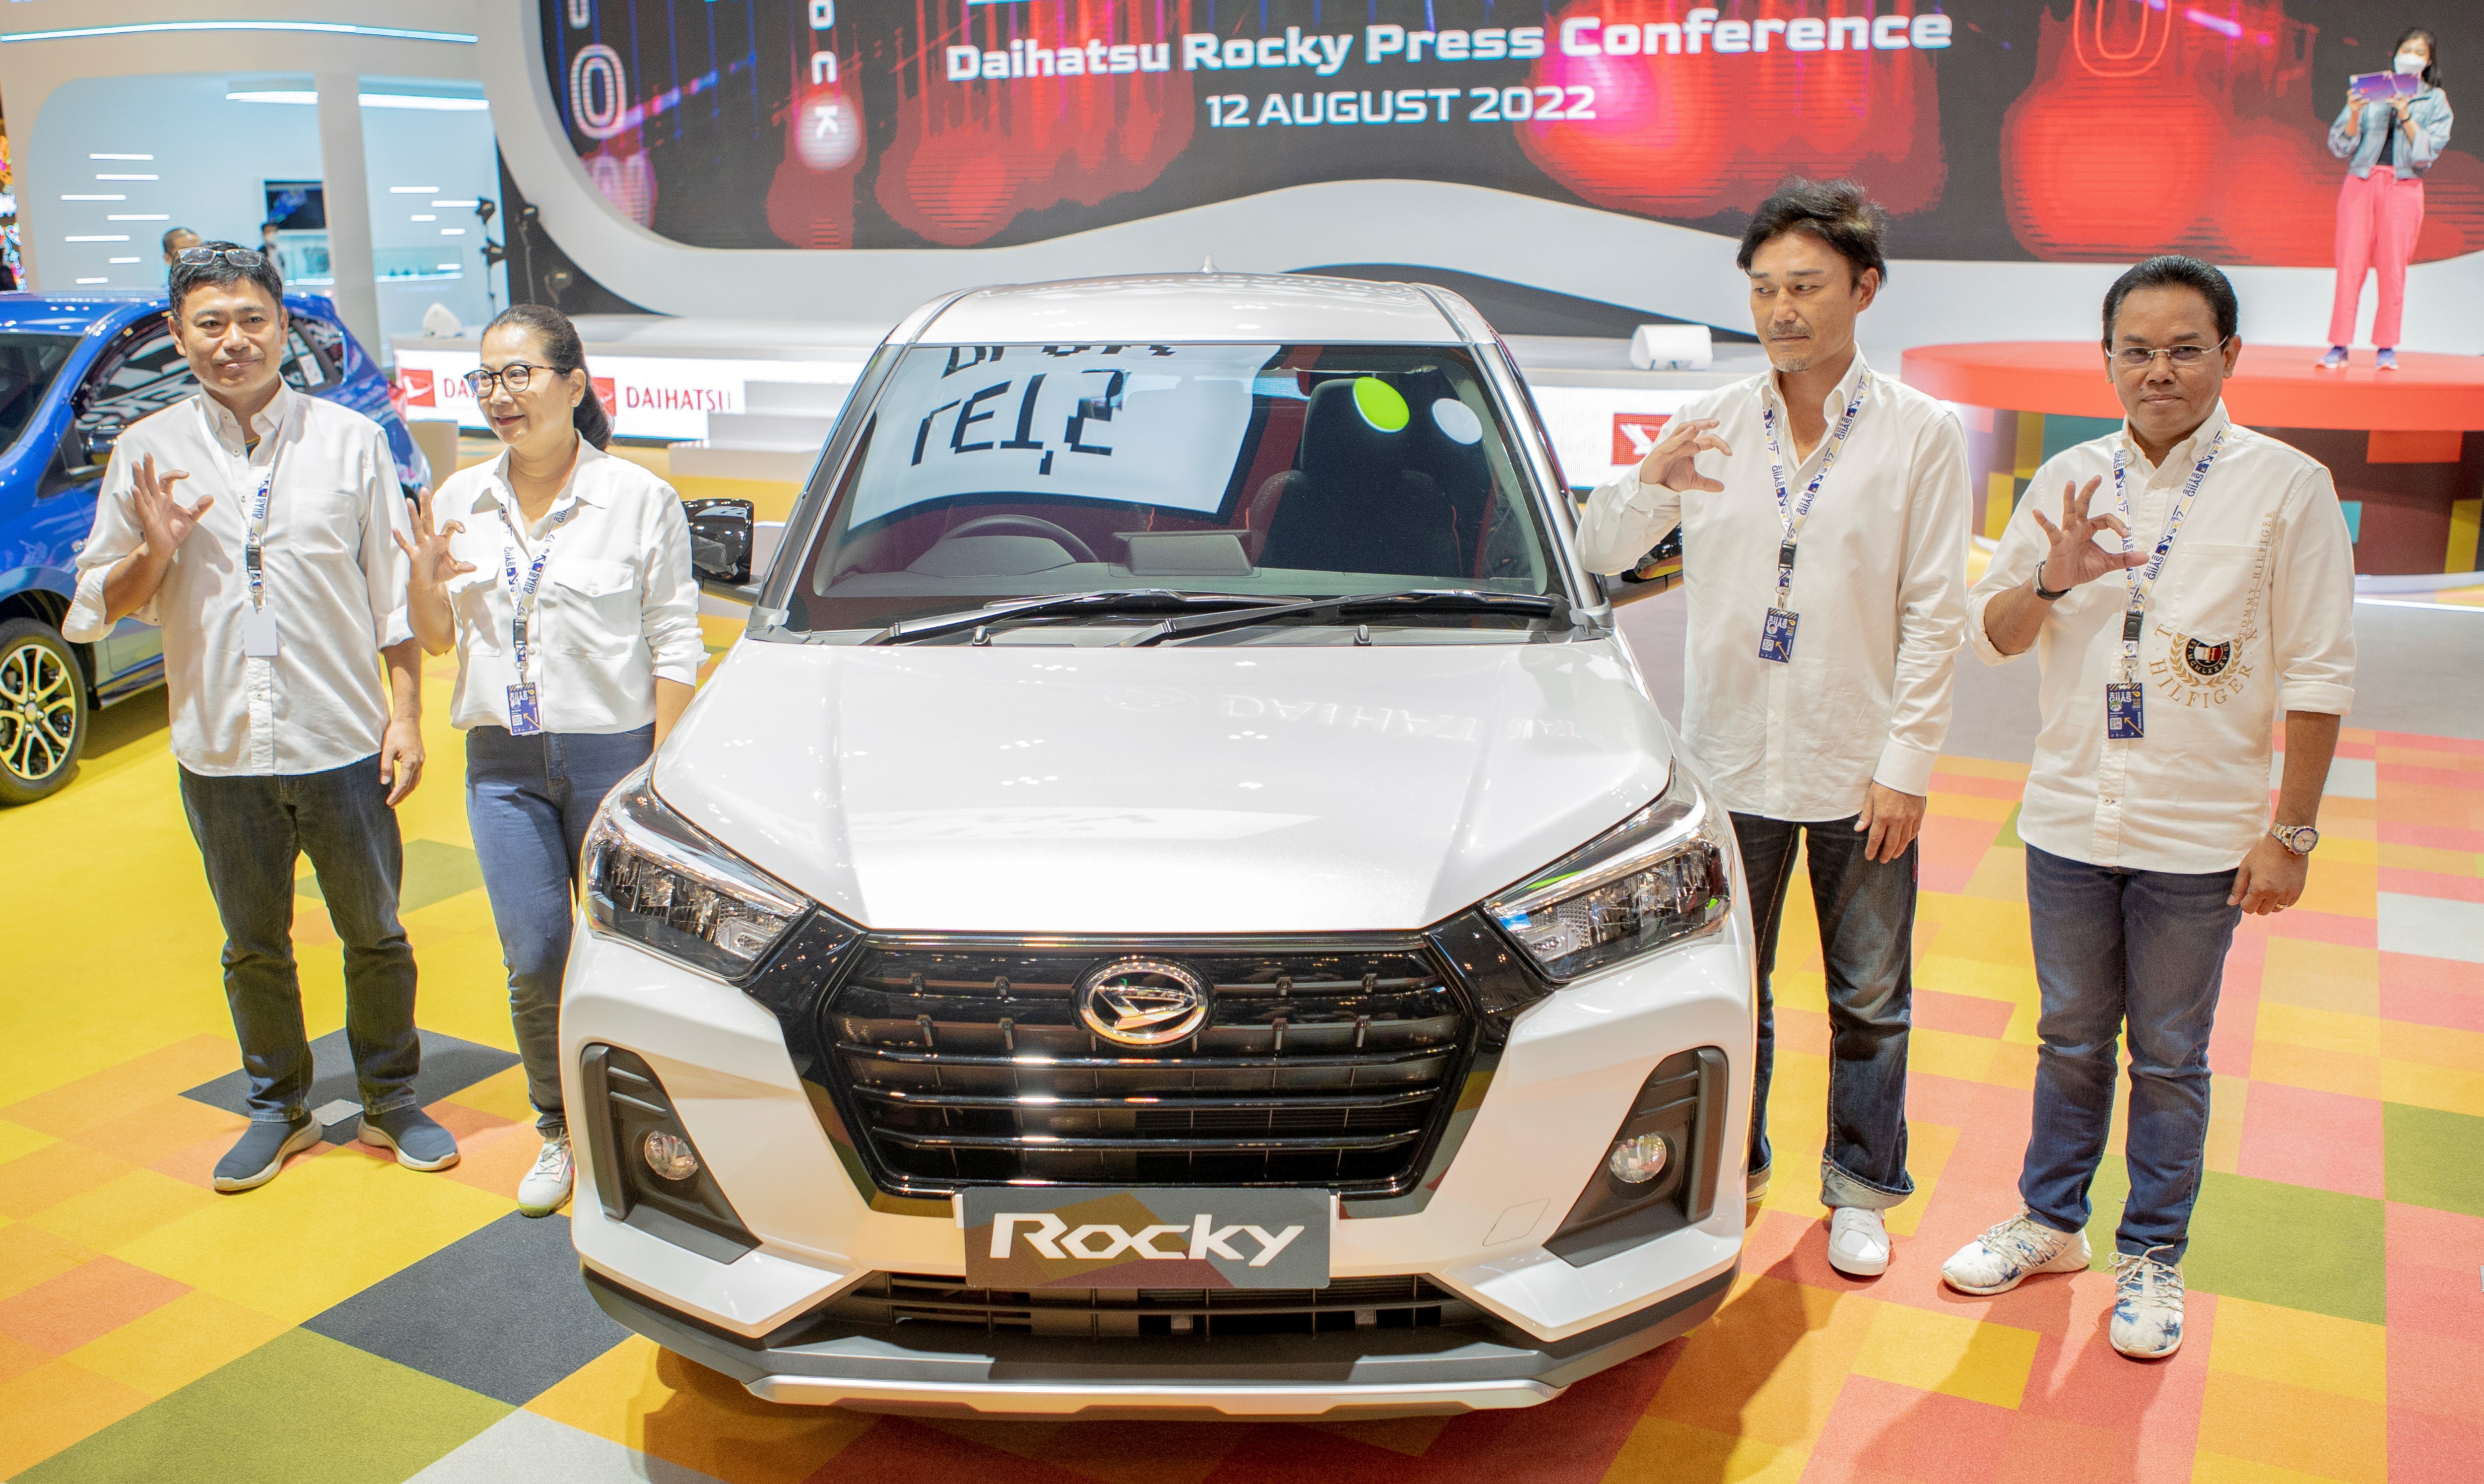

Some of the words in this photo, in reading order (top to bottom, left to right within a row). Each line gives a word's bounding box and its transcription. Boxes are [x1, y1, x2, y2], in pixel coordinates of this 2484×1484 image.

[946, 38, 1170, 81] Daihatsu
[1182, 26, 1353, 76] Rocky
[1366, 24, 1545, 62] Press
[1560, 8, 1952, 58] Conference
[1206, 95, 1250, 127] 12
[1257, 89, 1461, 126] AUGUST
[1468, 86, 1597, 122] 2022
[2253, 511, 2274, 580] HILFIGER
[2149, 658, 2254, 708] HILFIGER
[990, 1212, 1305, 1267] Rocky
